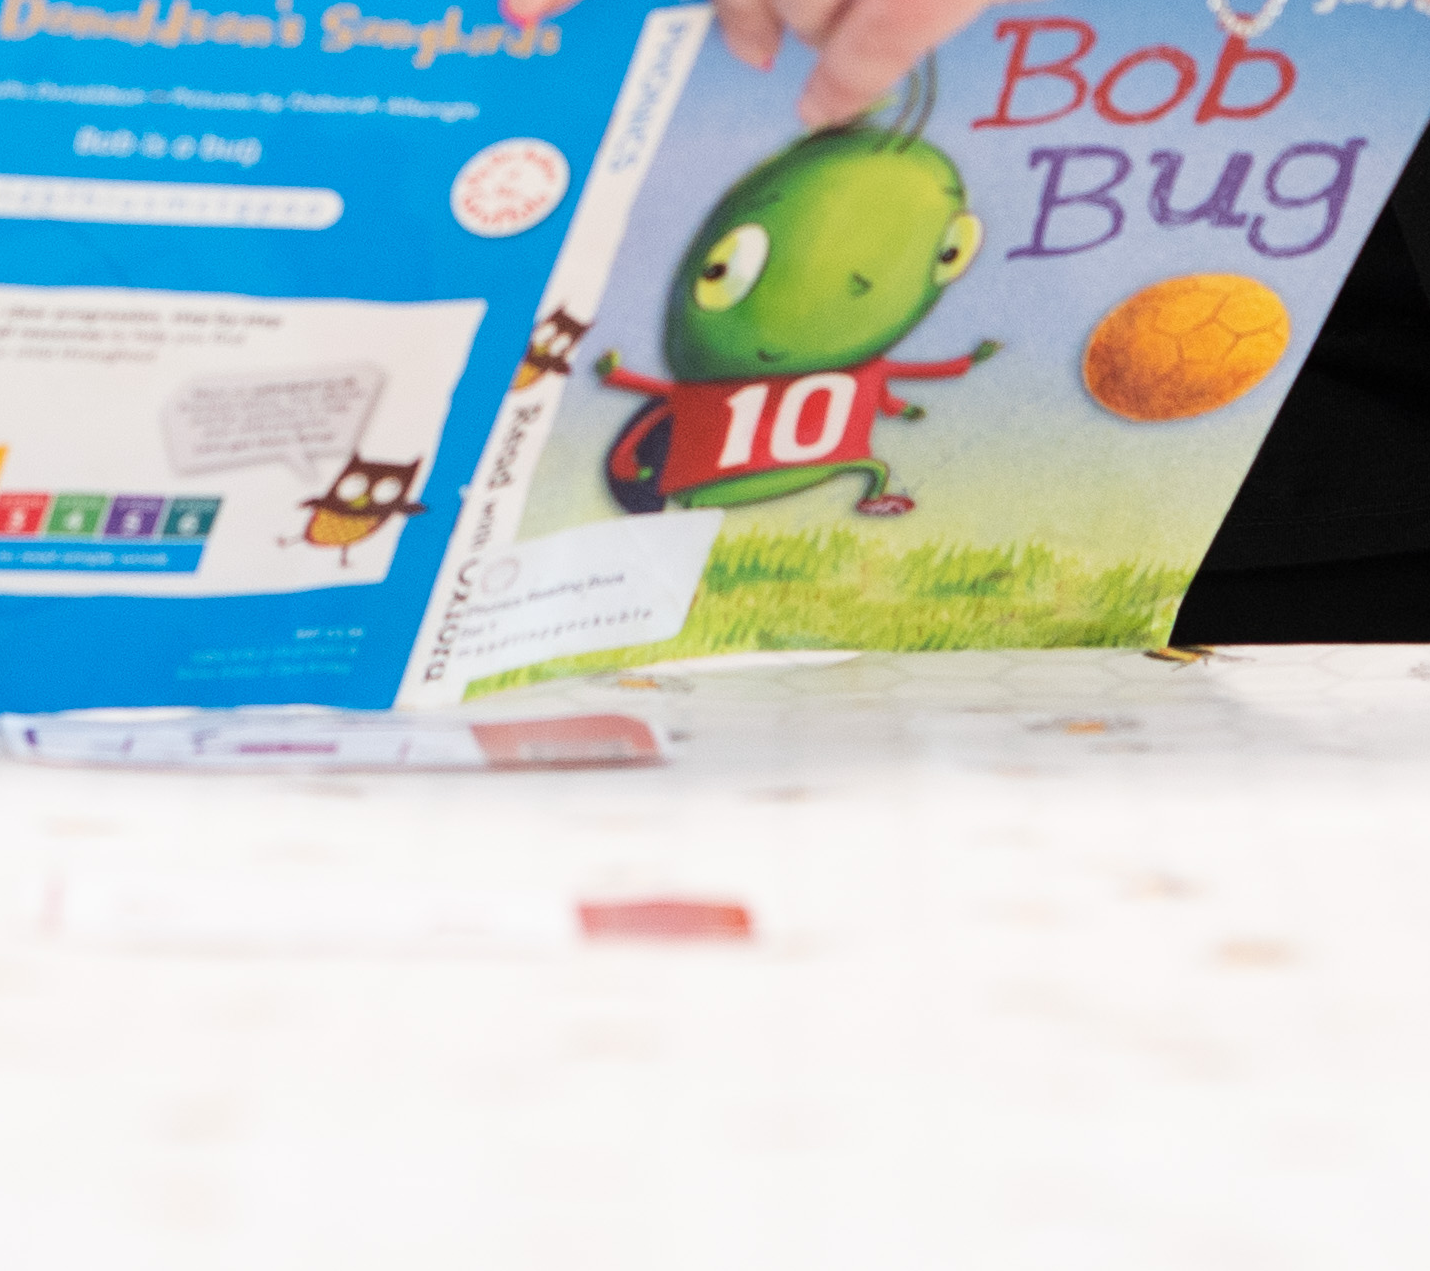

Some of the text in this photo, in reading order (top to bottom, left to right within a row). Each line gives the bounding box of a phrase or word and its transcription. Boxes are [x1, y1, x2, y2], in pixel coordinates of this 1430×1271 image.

[969, 13, 1298, 131] Bob
[1004, 136, 1369, 260] Bug
[488, 404, 542, 489] Read
[718, 371, 858, 470] 10
